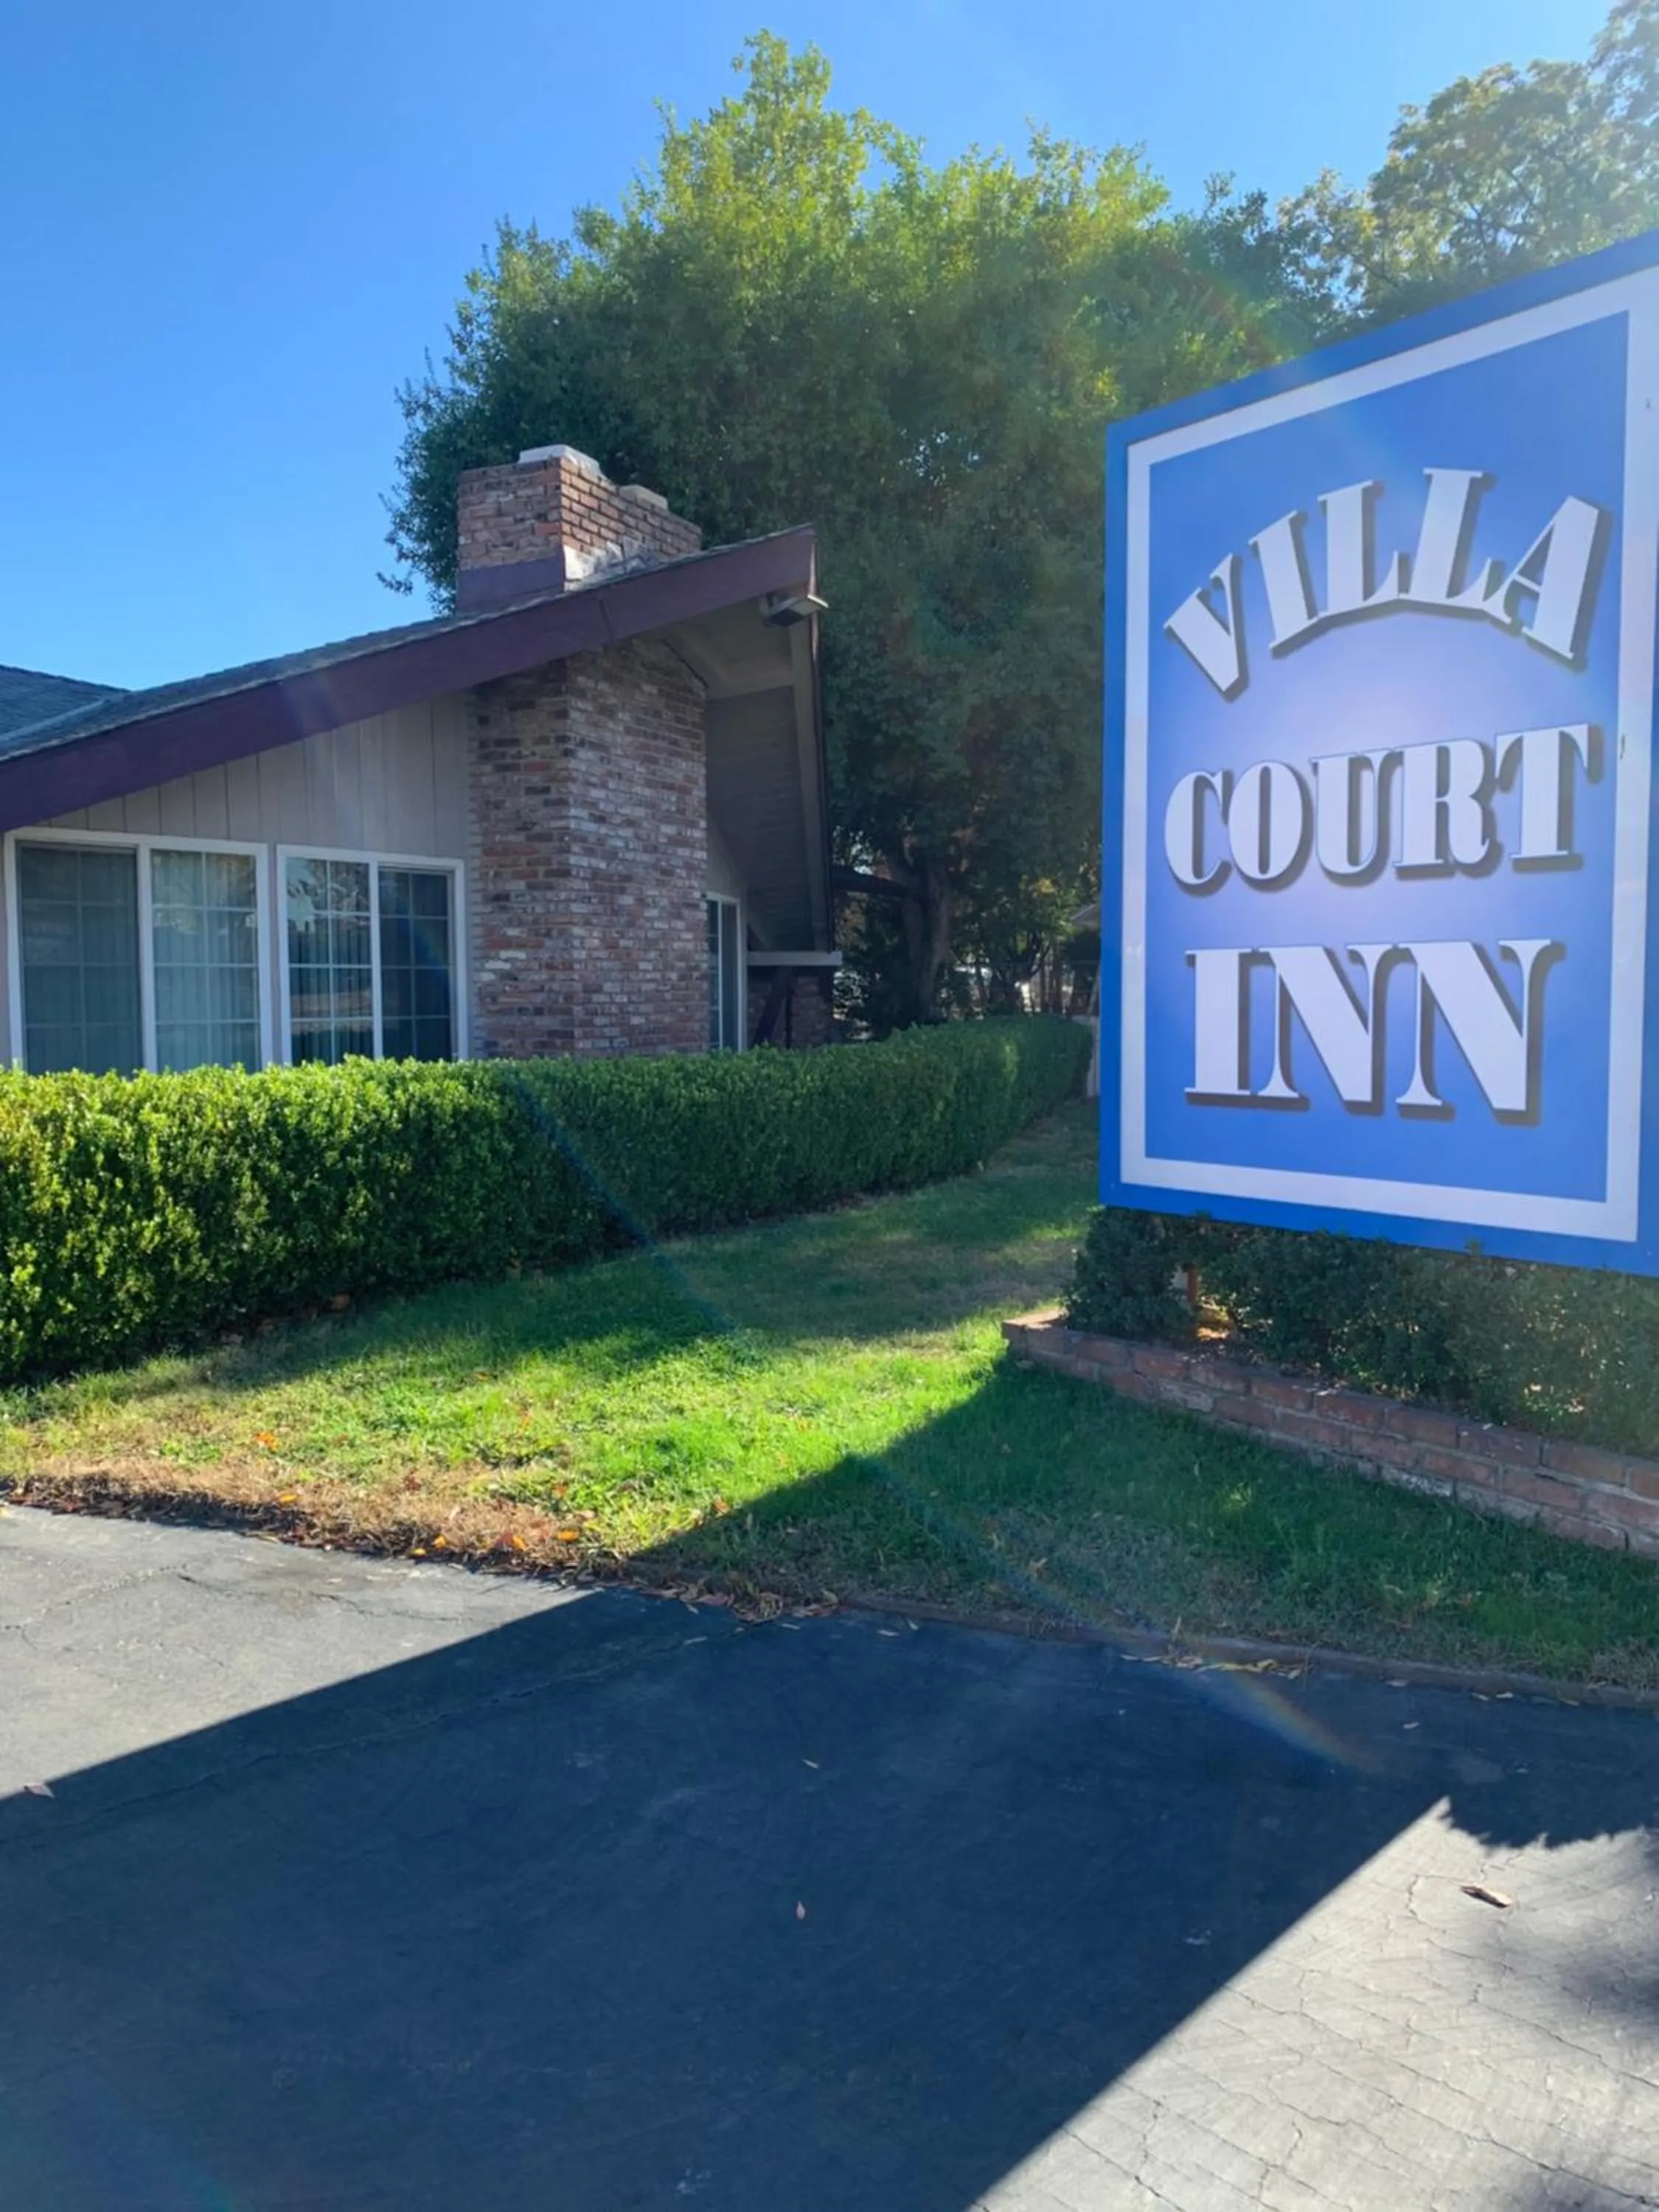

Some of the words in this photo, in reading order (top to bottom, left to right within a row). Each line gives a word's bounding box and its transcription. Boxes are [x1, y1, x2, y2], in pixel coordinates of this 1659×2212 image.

[1164, 467, 1601, 693] VILLA
[1164, 723, 1590, 886] COURT
[1184, 939, 1552, 1112] INN
